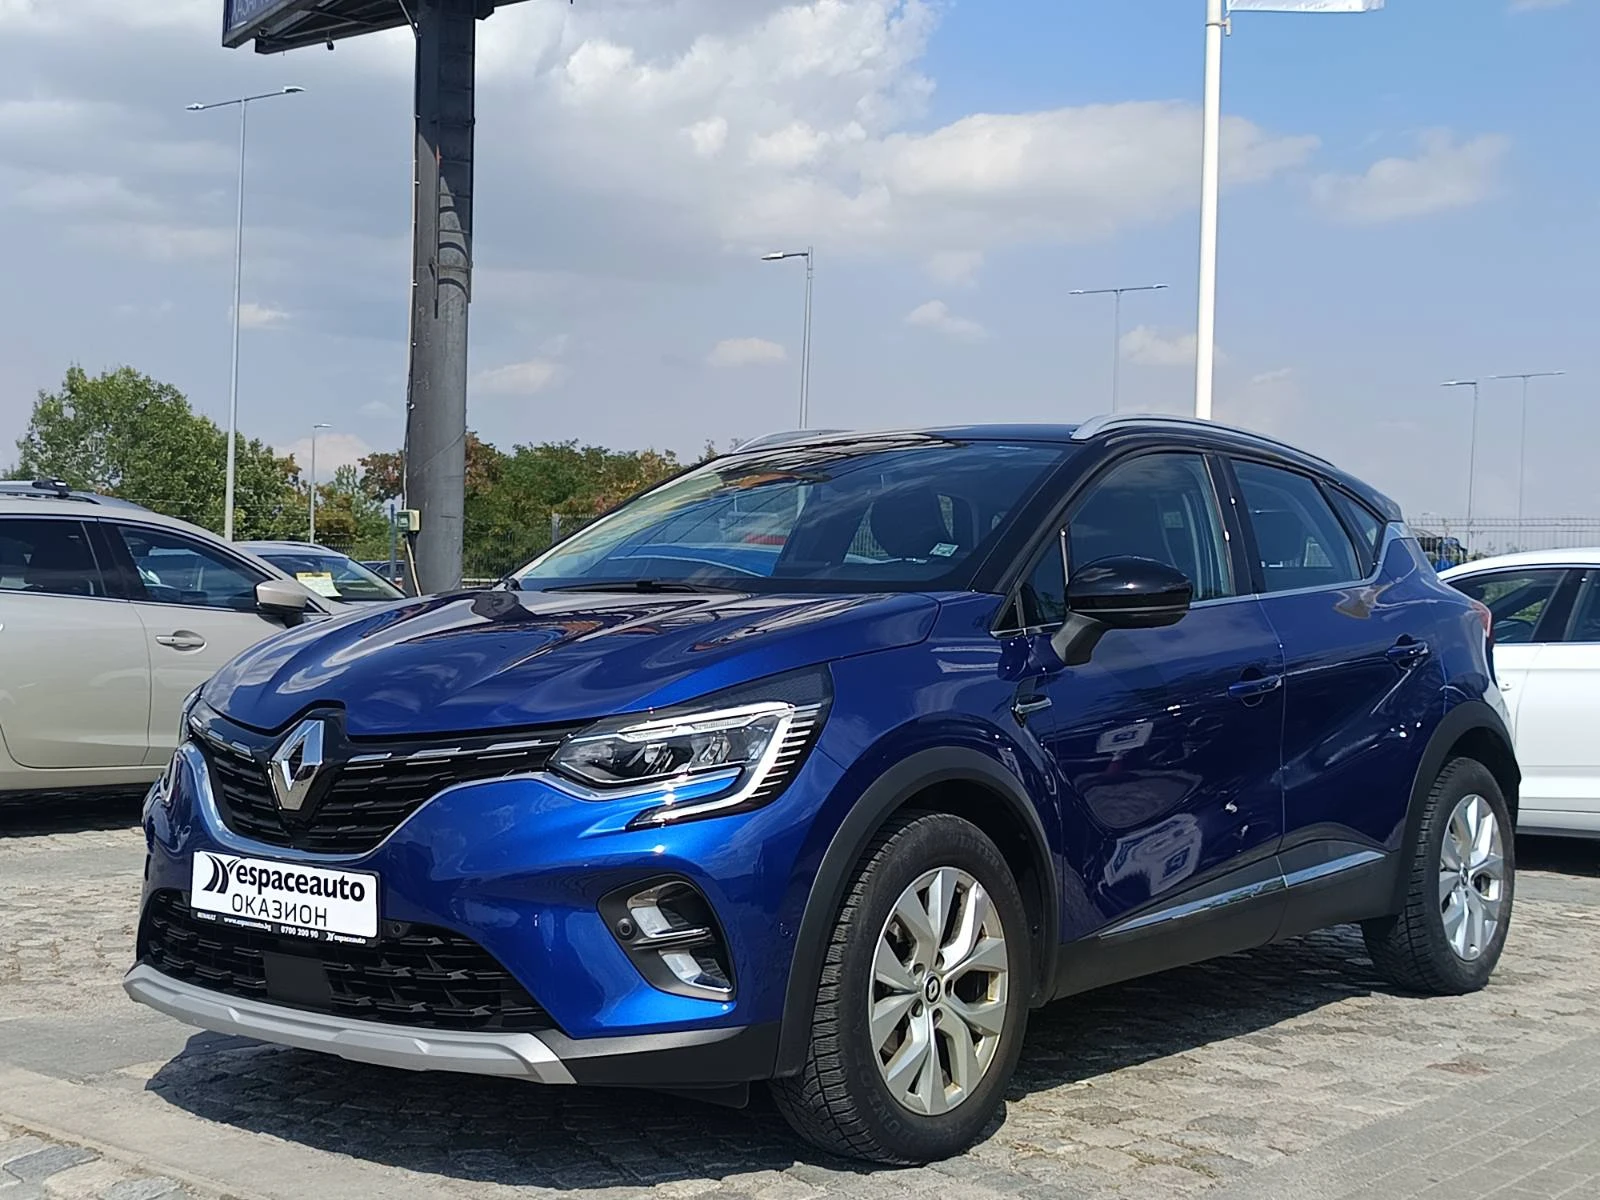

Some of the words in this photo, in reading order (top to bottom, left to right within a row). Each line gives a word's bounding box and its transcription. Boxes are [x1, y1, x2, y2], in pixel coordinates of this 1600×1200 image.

[236, 864, 365, 902] espaceauto
[232, 893, 327, 927] ОКАЗИОН
[280, 925, 297, 936] 0700
[297, 928, 309, 938] 200
